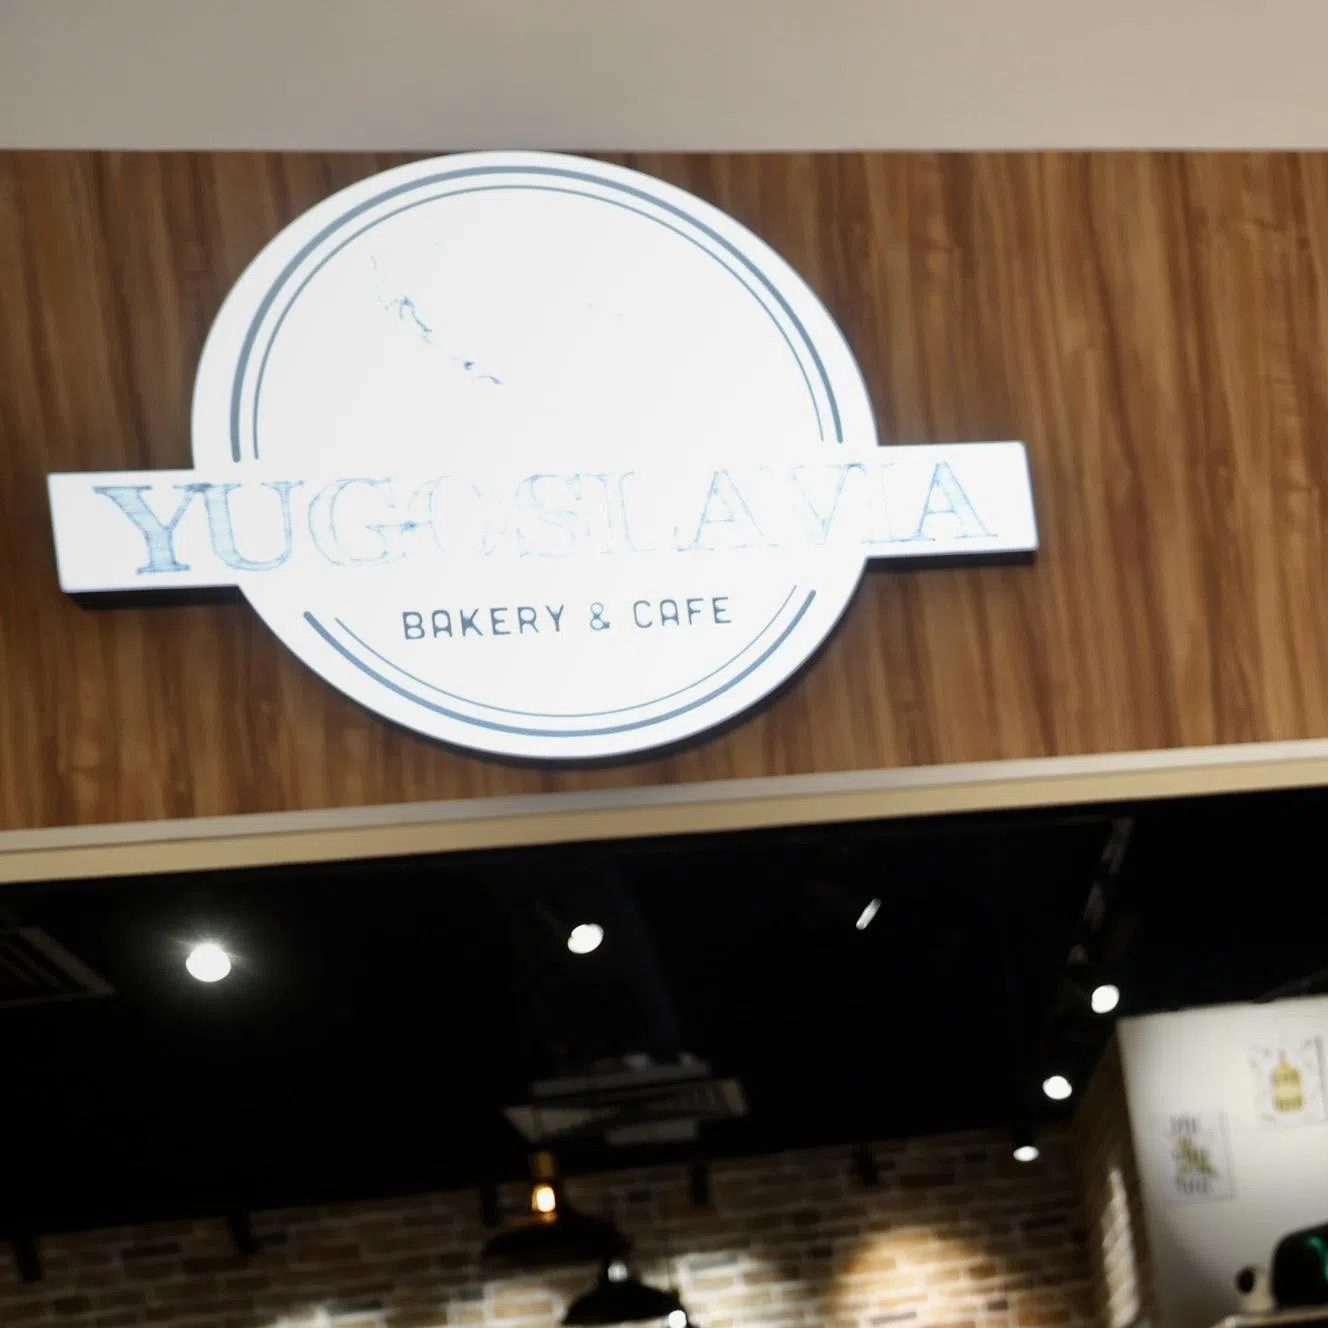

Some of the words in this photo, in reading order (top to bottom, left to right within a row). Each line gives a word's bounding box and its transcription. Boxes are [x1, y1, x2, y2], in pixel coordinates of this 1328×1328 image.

[402, 604, 565, 640] BAKERY
[589, 601, 611, 631] &
[633, 596, 732, 629] CAFE
